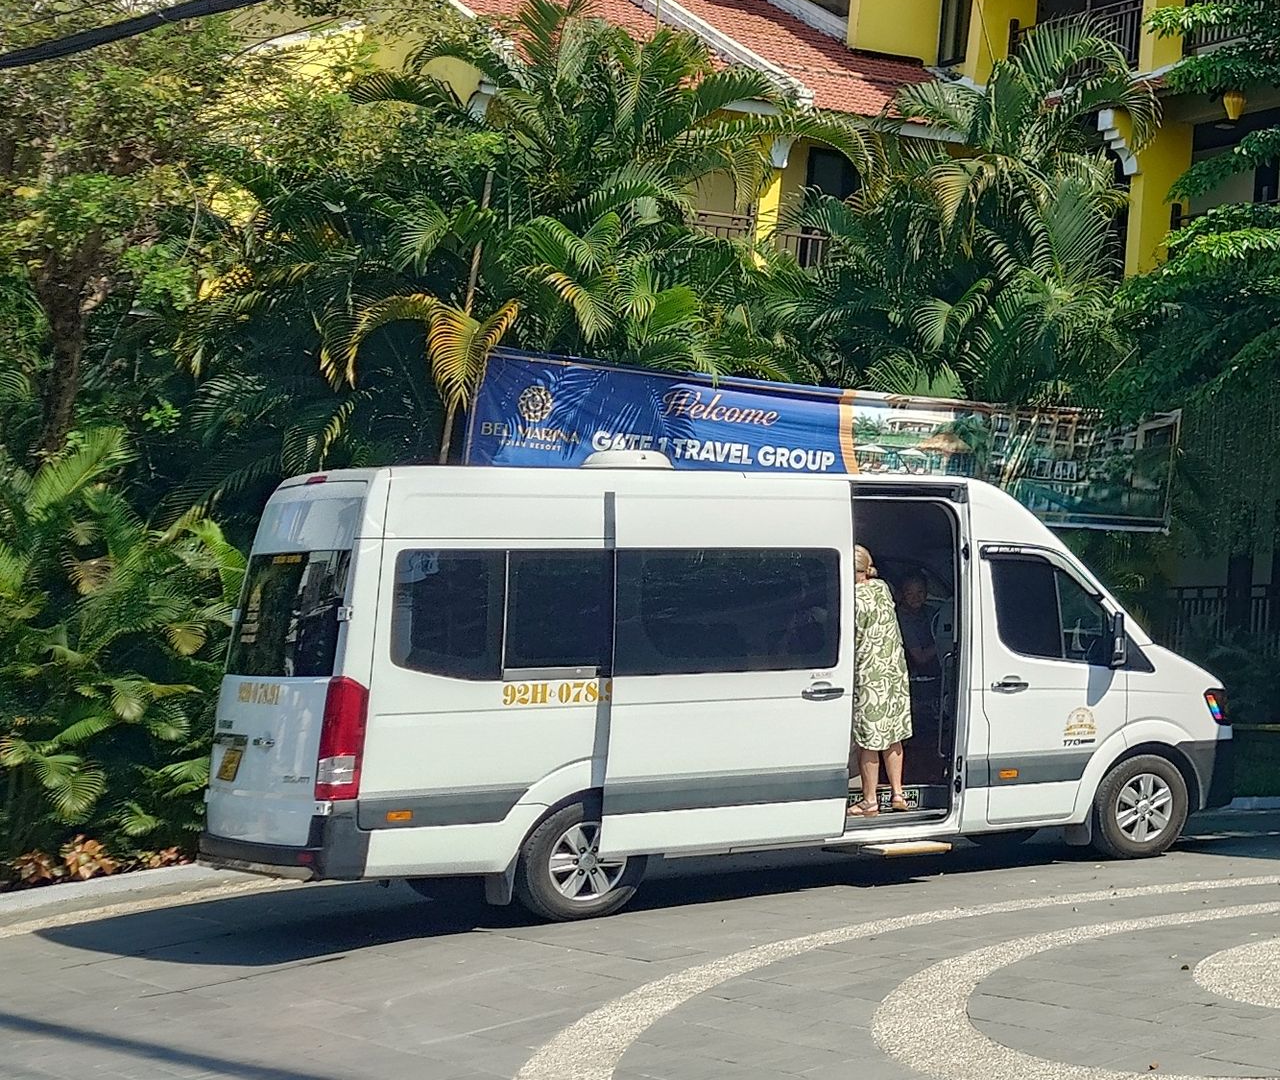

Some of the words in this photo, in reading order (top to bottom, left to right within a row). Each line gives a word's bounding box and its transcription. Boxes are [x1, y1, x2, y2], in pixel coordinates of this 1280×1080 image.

[661, 388, 781, 427] Welcome
[480, 421, 512, 438] BEL
[529, 441, 562, 452] RESORT
[591, 430, 653, 452] GATE
[657, 437, 668, 455] 1
[673, 438, 753, 465] TRAVEL
[757, 445, 836, 471] GROUP
